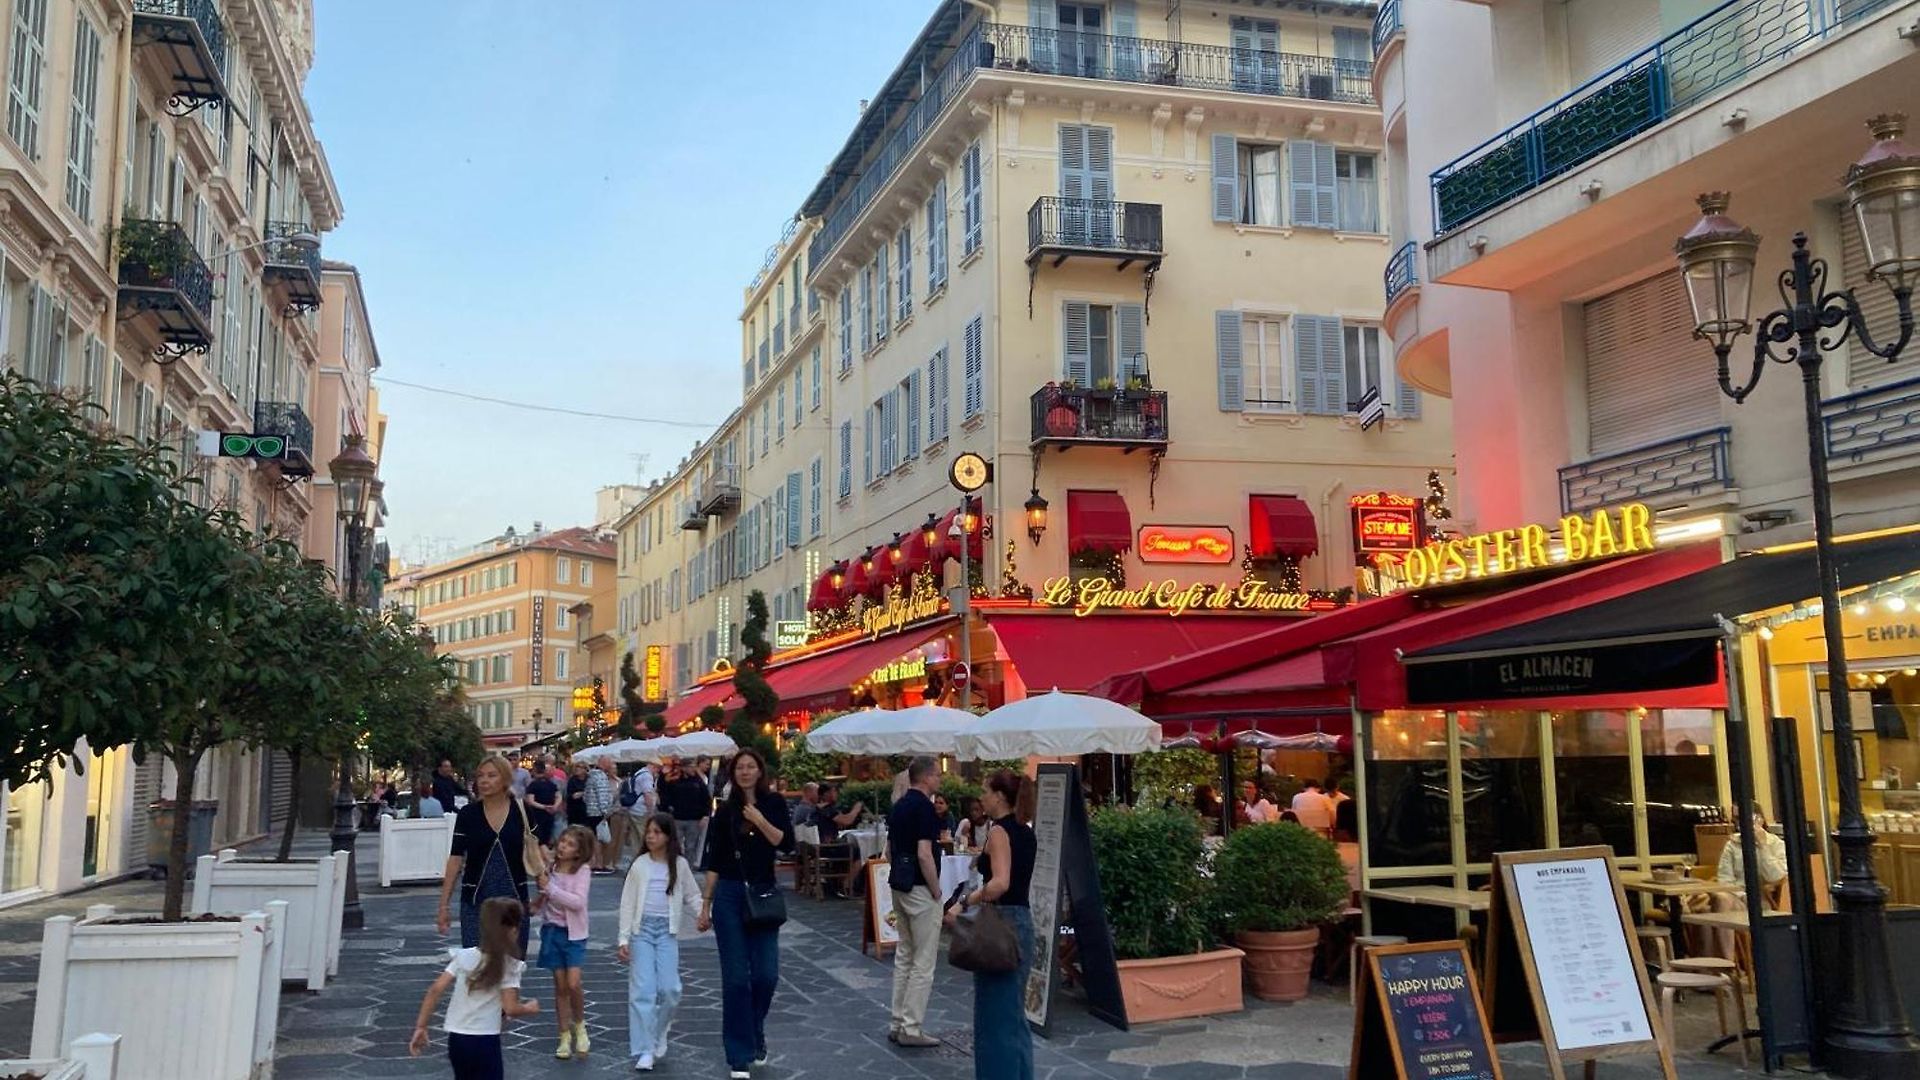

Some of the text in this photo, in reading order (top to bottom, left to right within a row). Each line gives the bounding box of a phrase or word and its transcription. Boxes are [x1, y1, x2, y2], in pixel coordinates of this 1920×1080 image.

[1364, 521, 1398, 535] STEAK
[1405, 524, 1552, 588] OYSTER
[1559, 502, 1654, 562] BAR
[1044, 577, 1310, 617] Le Grand Café de France
[1500, 655, 1593, 682] EL ALMACEN
[1388, 976, 1465, 995] HAPPY HOUR
